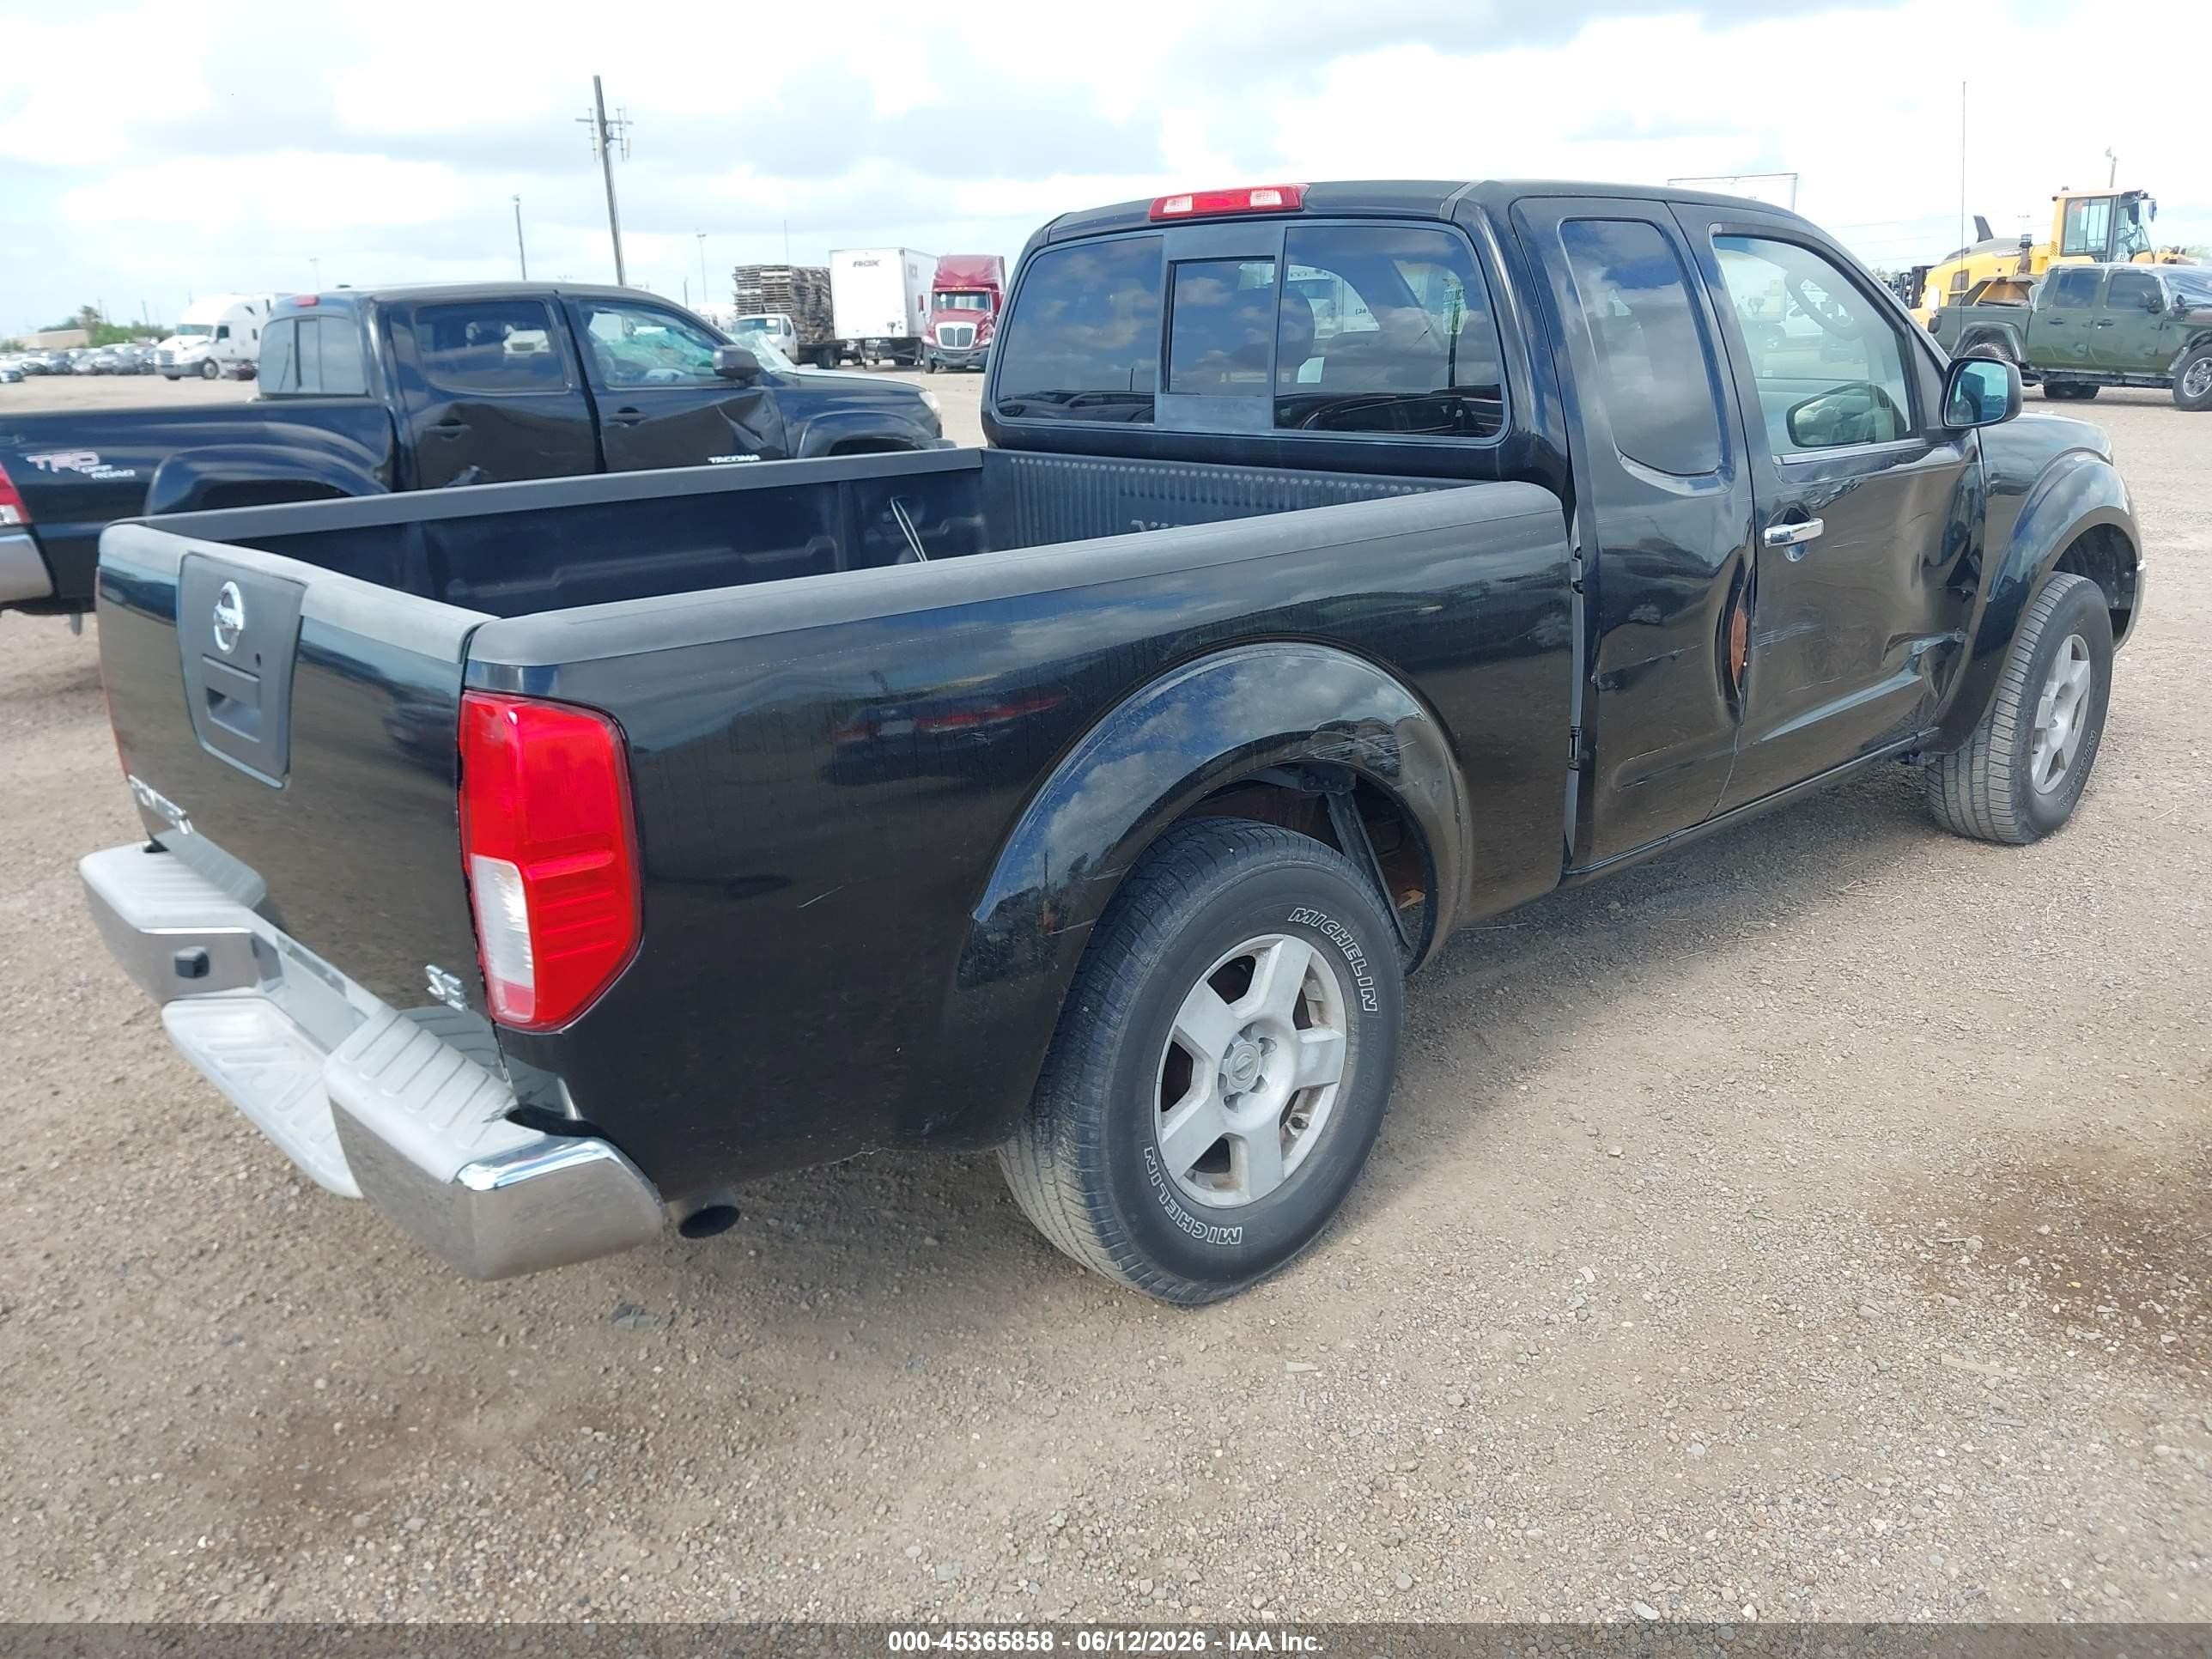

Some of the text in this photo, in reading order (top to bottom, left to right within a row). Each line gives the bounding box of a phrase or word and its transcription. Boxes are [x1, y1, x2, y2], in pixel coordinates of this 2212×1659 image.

[26, 451, 100, 473] TRD
[707, 454, 762, 464] TACOMA
[1287, 907, 1378, 1012] MICHELIN
[1144, 1146, 1243, 1245] MICHELIN
